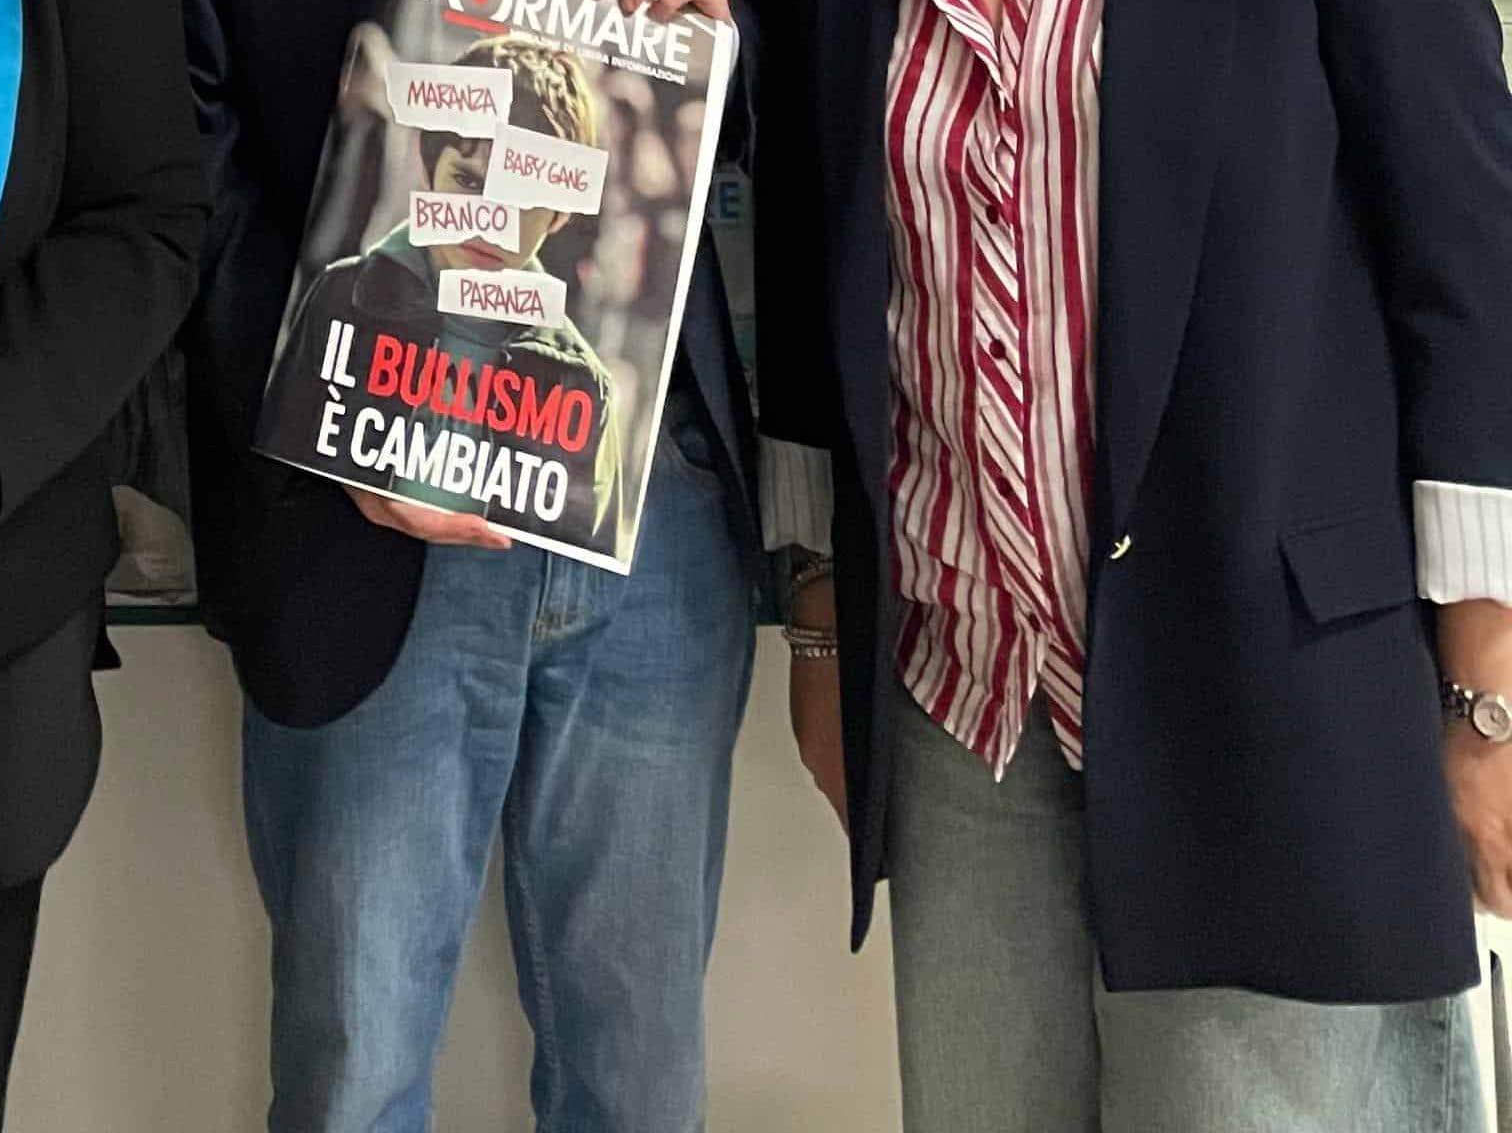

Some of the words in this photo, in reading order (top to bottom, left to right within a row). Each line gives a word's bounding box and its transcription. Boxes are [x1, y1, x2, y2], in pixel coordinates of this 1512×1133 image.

[407, 80, 498, 116] MARANZA
[503, 148, 548, 182] BABY
[547, 162, 589, 192] GANG
[415, 197, 509, 232] BRANCO
[459, 278, 545, 319] PARANZA
[320, 319, 356, 389] IL
[366, 333, 594, 453] BULLISMO
[315, 384, 346, 458] È
[350, 407, 569, 523] CAMBIATO
